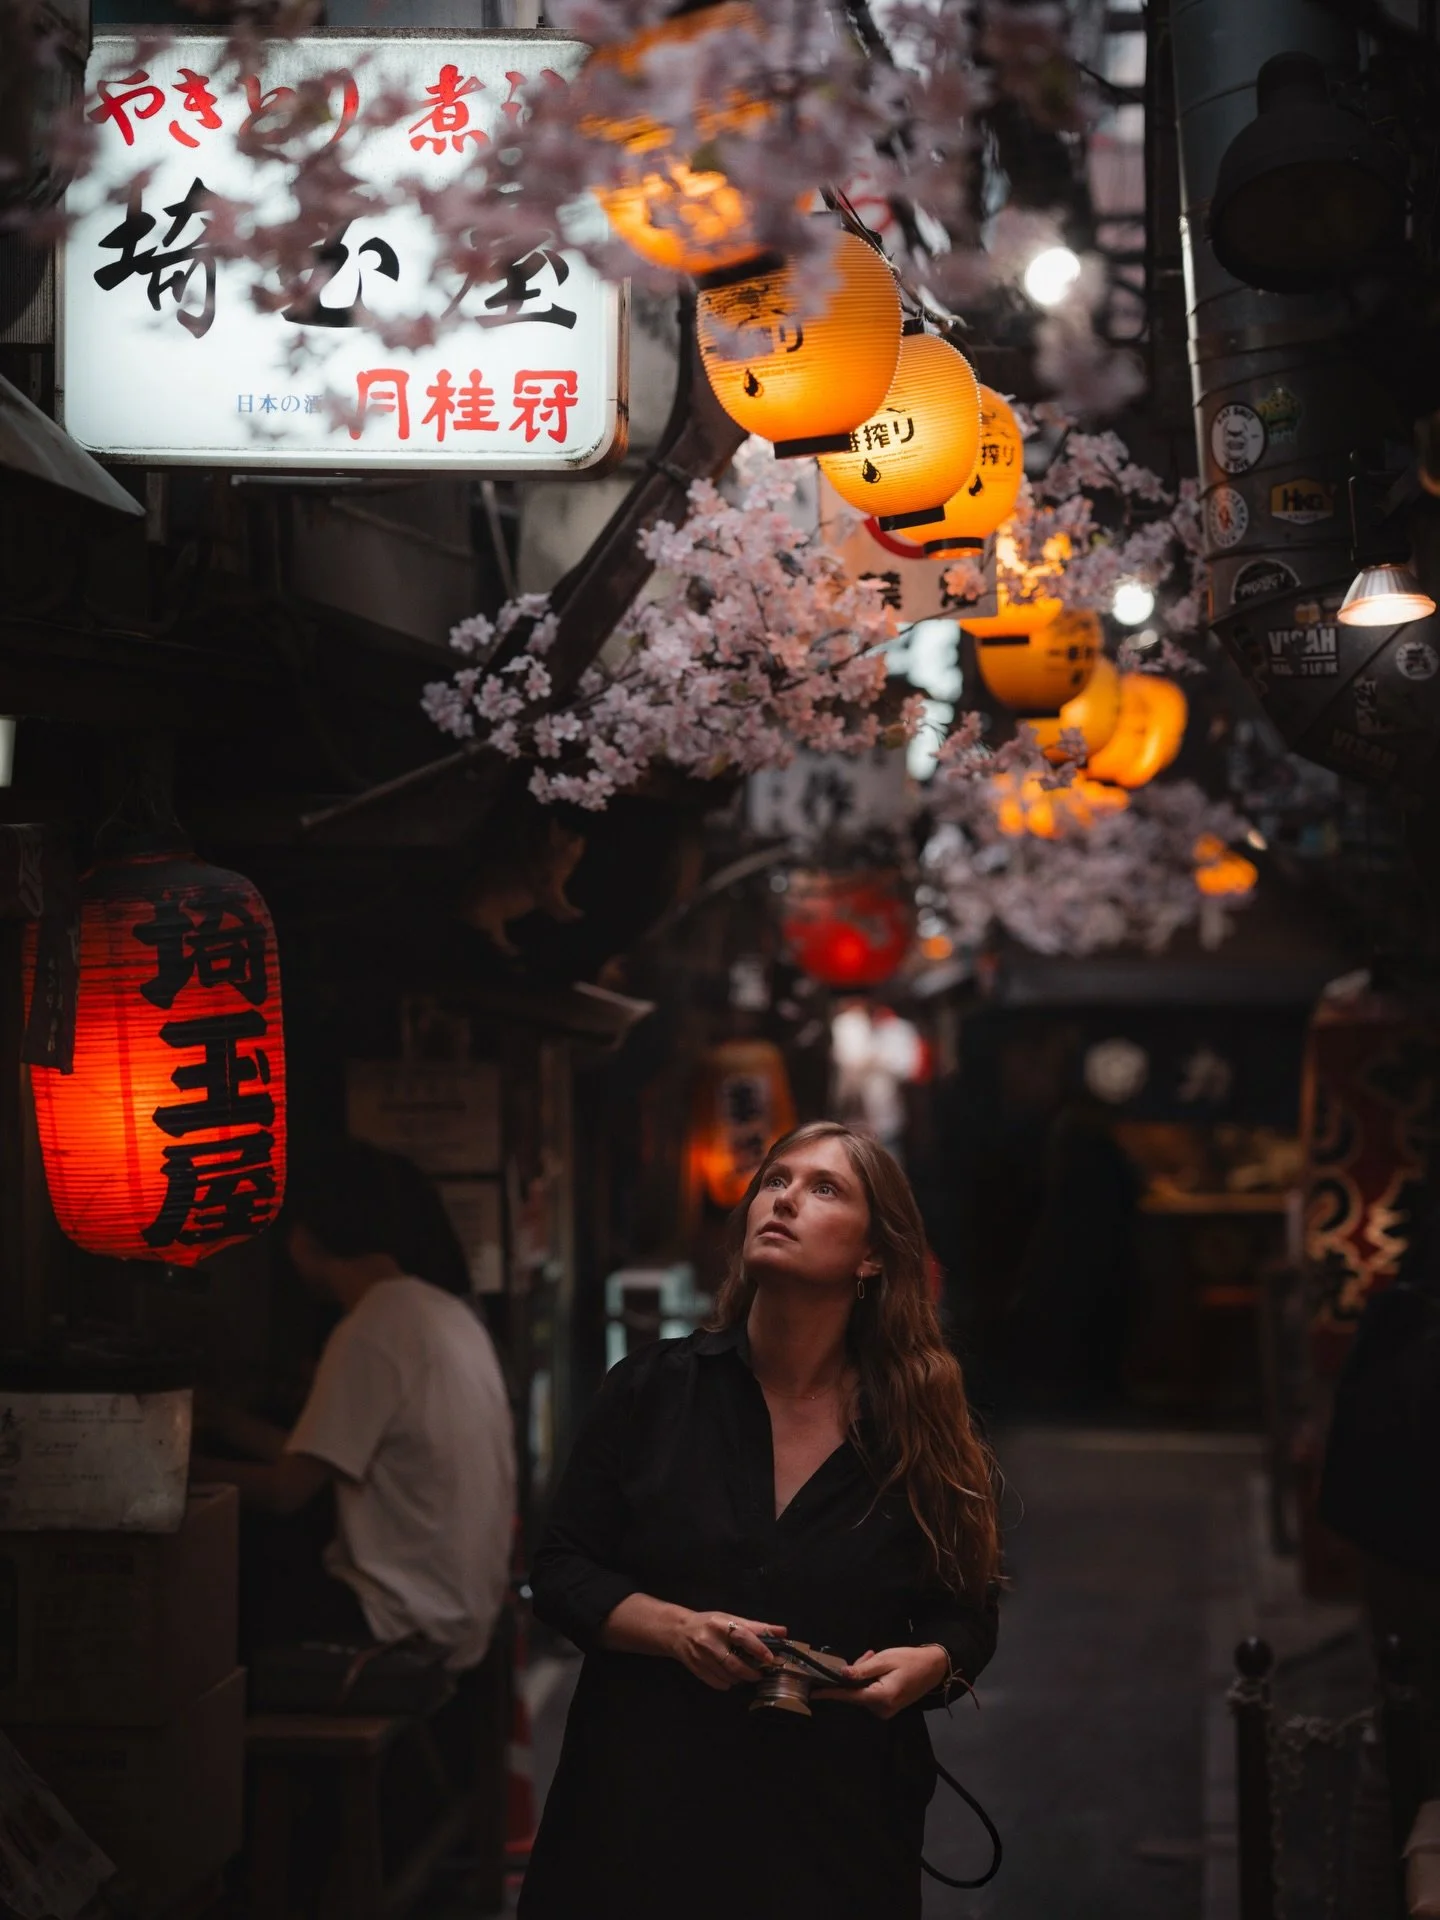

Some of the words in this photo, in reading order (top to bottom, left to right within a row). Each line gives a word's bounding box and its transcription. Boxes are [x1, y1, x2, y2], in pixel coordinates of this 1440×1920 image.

[87, 67, 360, 149] やきとり
[237, 393, 323, 415] 日本の酒
[349, 367, 578, 444] 月桂冠
